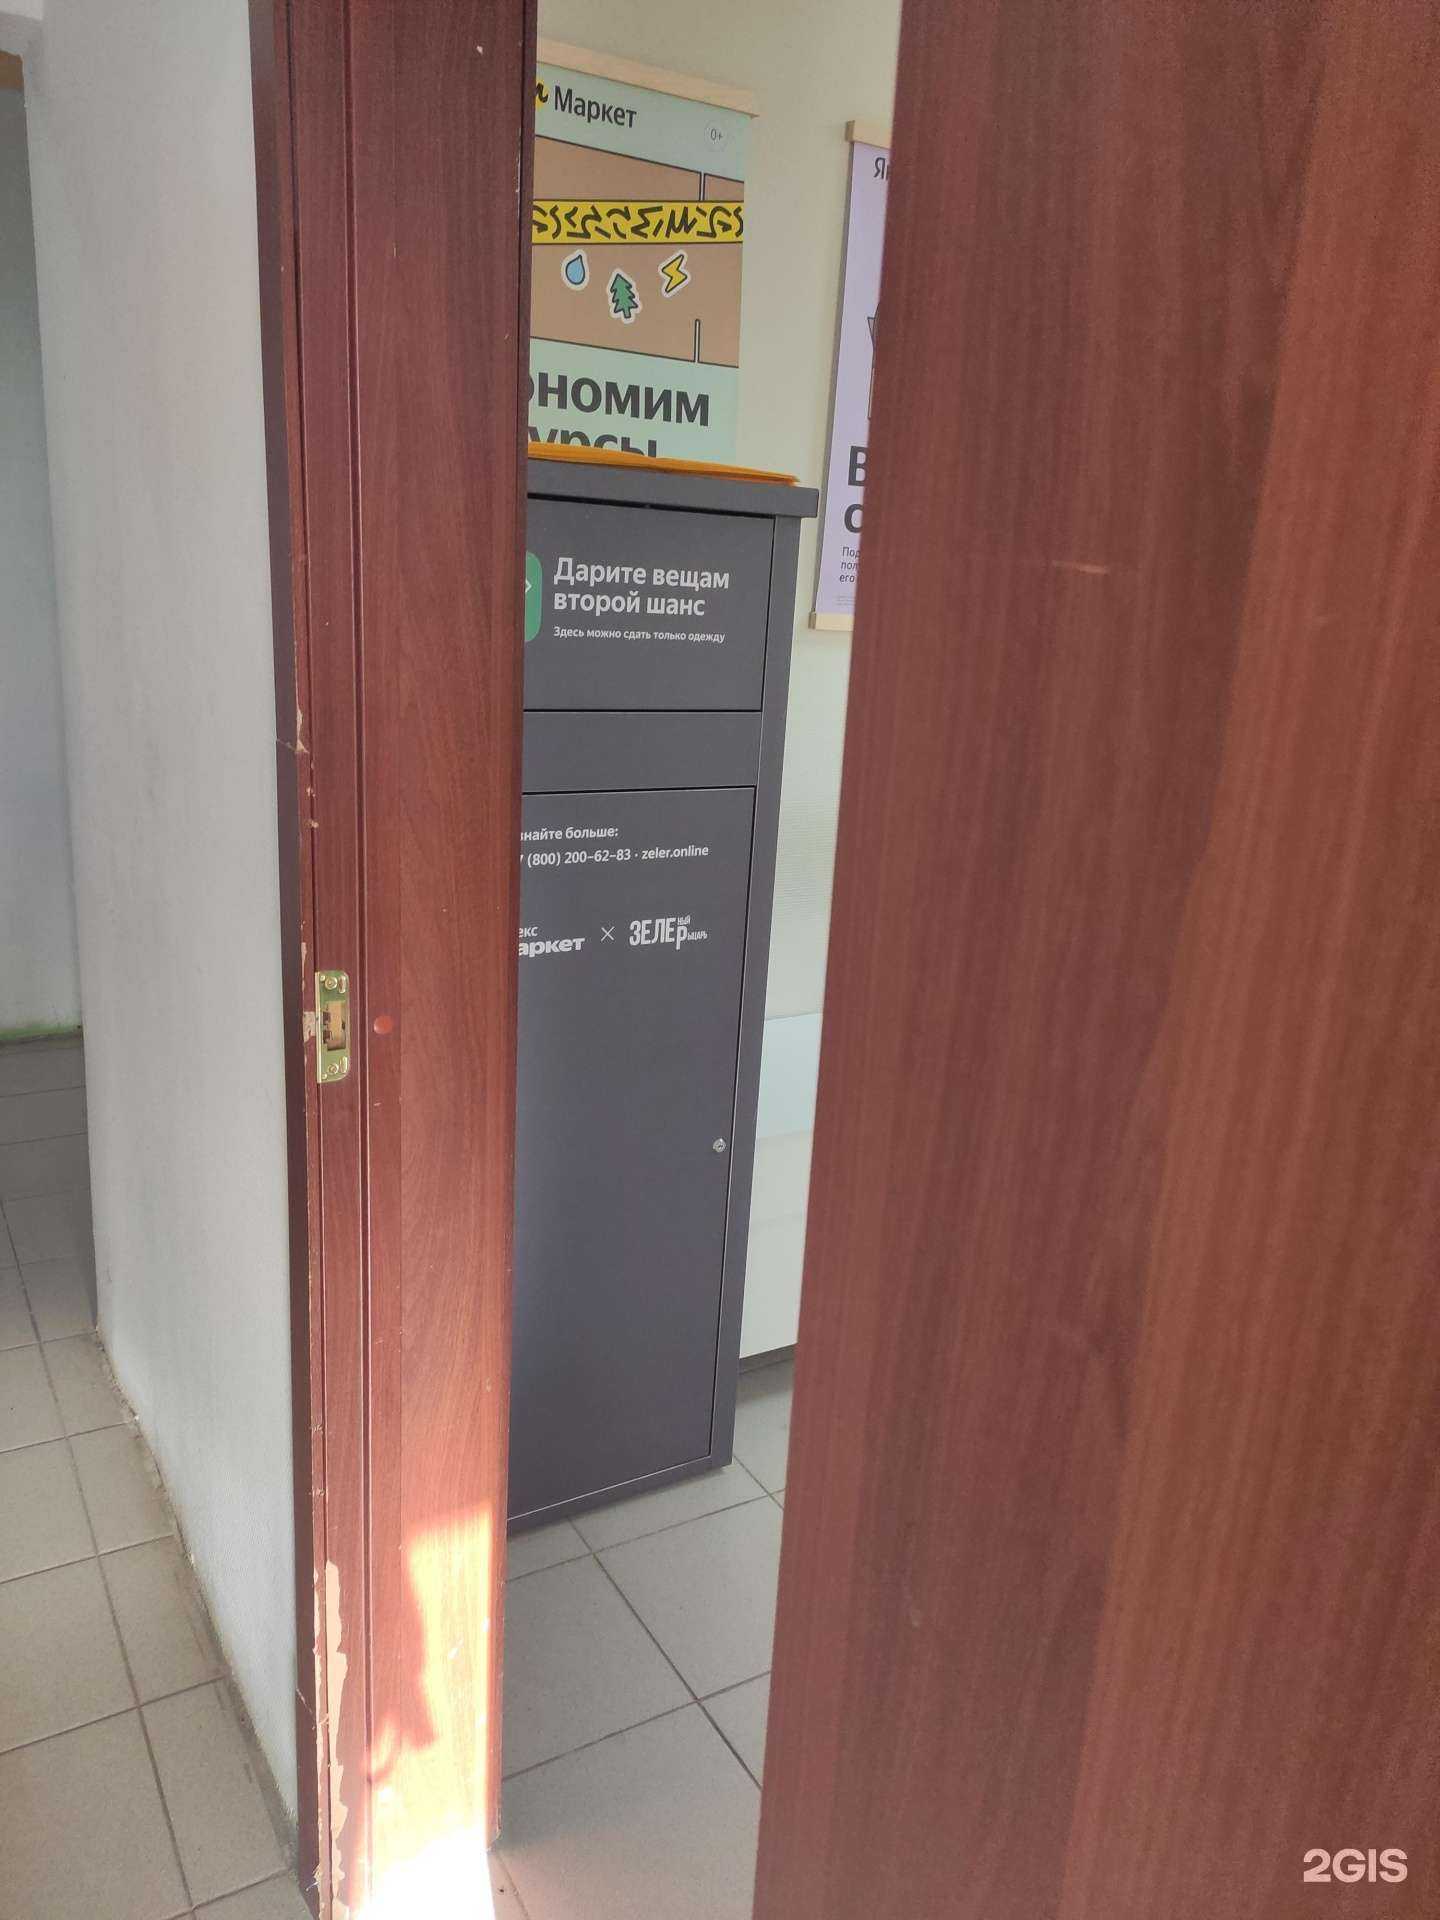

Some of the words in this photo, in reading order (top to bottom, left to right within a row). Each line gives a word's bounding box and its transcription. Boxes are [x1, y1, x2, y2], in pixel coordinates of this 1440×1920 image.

[554, 85, 637, 128] Маркет
[710, 128, 723, 141] 0+
[553, 556, 647, 587] Дарите
[652, 568, 730, 592] вещам
[553, 590, 641, 617] второй
[646, 597, 706, 616] шанс
[553, 626, 585, 639] Здесь
[586, 629, 622, 639] можно
[623, 630, 651, 640] сдать
[652, 631, 687, 641] только
[688, 633, 726, 644] одежду
[565, 826, 619, 839] больше:
[527, 852, 561, 868] (800)
[564, 848, 631, 864] 200-62-83
[641, 844, 709, 860] zeler.online
